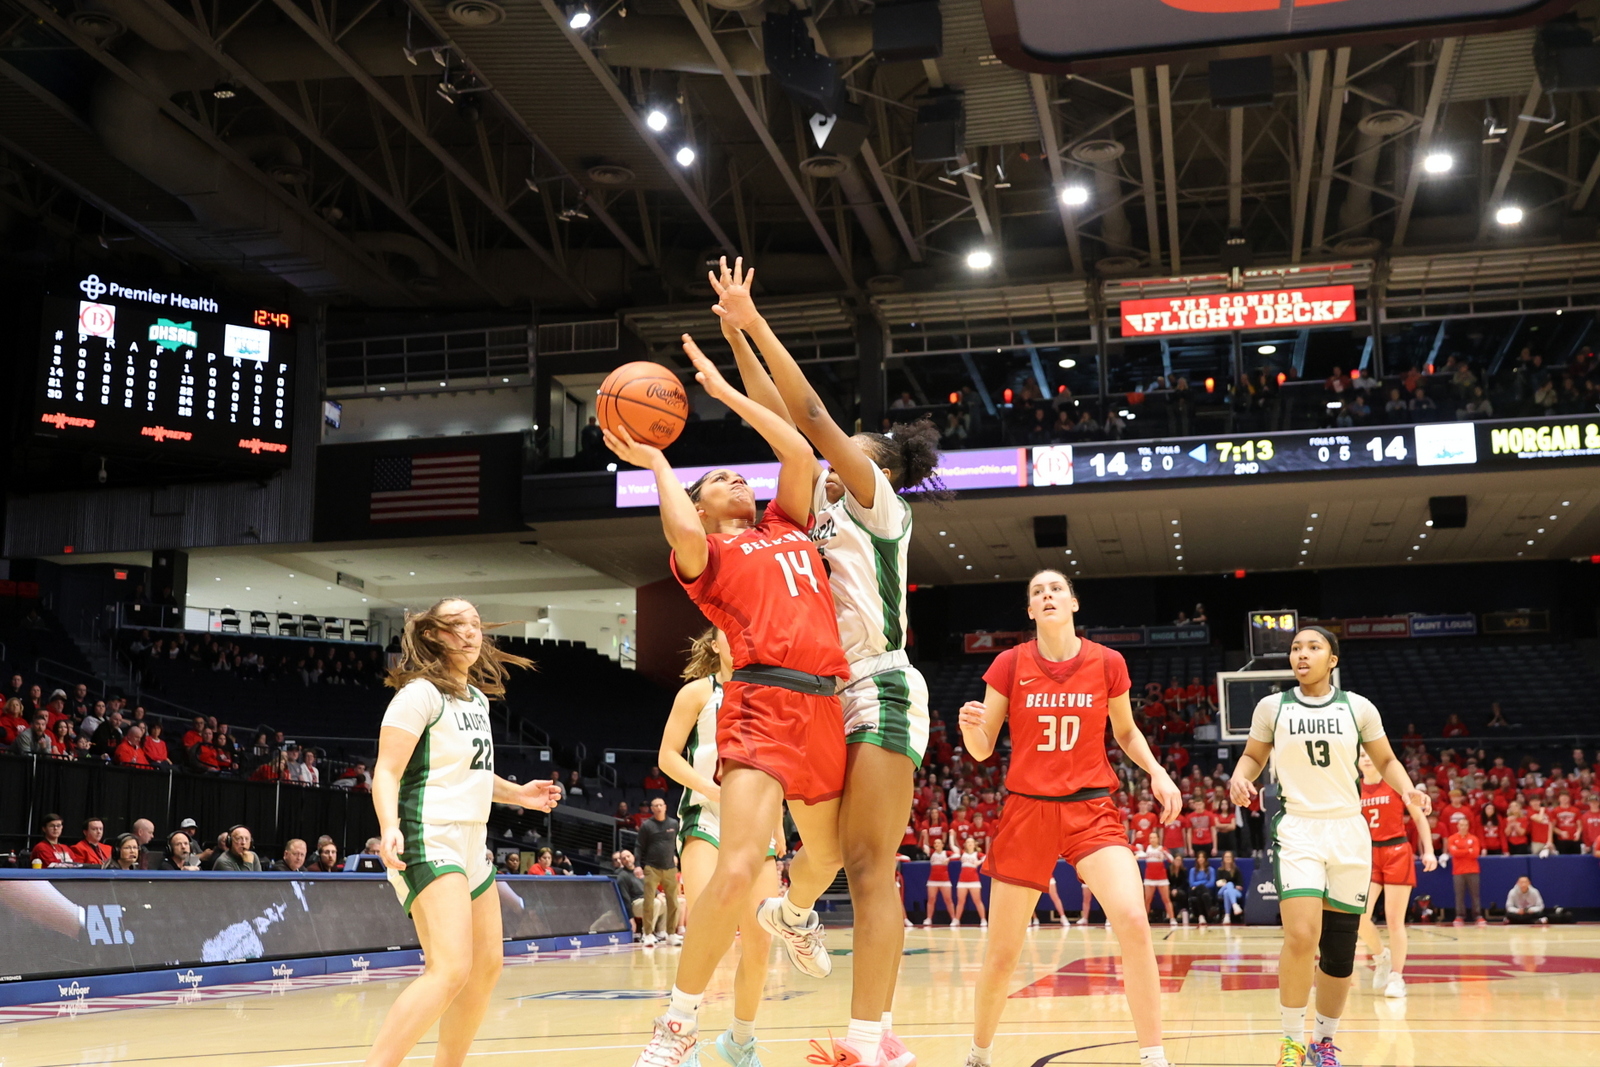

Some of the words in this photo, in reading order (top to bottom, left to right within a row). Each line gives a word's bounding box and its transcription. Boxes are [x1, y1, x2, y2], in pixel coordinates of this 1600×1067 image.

[110, 282, 167, 305] Premier
[170, 293, 219, 313] Health
[1170, 298, 1210, 311] THE
[1219, 292, 1304, 309] CONNOR
[254, 310, 289, 328] 12:49
[1142, 306, 1249, 332] FLIGHT
[1255, 301, 1334, 325] DECK
[79, 334, 88, 344] P
[106, 338, 116, 349] R
[130, 342, 138, 352] A
[156, 345, 164, 356] F
[149, 325, 198, 347] OHSAA
[78, 348, 87, 358] 0
[104, 352, 110, 361] 1
[127, 356, 133, 365] 1
[150, 359, 158, 368] 0
[208, 353, 216, 363] P
[233, 357, 241, 367] R
[255, 360, 263, 371] A
[280, 364, 287, 373] F
[50, 366, 64, 377] 14
[77, 371, 85, 380] 0
[126, 378, 134, 387] 0
[148, 381, 156, 390] 0
[78, 360, 86, 368] 0
[104, 363, 112, 372] 0
[127, 366, 134, 376] 0
[149, 370, 157, 379] 0
[184, 364, 190, 373] 1
[209, 368, 216, 377] 0
[255, 374, 262, 384] 0
[277, 378, 284, 387] 0
[102, 385, 110, 394] 0
[125, 389, 133, 398] 0
[148, 391, 155, 401] 0
[209, 378, 216, 387] 0
[232, 381, 239, 391] 0
[254, 385, 262, 394] 0
[276, 388, 284, 397] 0
[47, 389, 62, 399] 30
[147, 402, 153, 411] 1
[208, 389, 216, 399] 0
[232, 392, 239, 402] 0
[254, 396, 260, 404] 1
[276, 398, 283, 408] 0
[42, 412, 95, 429] MAXPREPS
[230, 413, 236, 423] 1
[253, 416, 260, 426] 0
[275, 419, 282, 429] 0
[276, 408, 283, 418] 0
[141, 425, 192, 442] MAXPREPS
[1309, 437, 1335, 446] FOULS
[1491, 424, 1580, 454] MORGAN
[1585, 423, 1600, 448] &
[238, 438, 287, 454] MAXPREPS
[1155, 445, 1180, 455] FOULS
[1216, 440, 1274, 462] 7:13
[1318, 447, 1330, 462] 0
[1339, 446, 1351, 461] 5
[1366, 435, 1407, 461] 14
[1090, 452, 1128, 477] 14
[1141, 457, 1152, 471] 5
[1162, 456, 1173, 470] 0
[1234, 463, 1259, 475] 2ND
[619, 485, 627, 494] Is
[628, 484, 650, 494] Your
[774, 550, 820, 597] 14
[1413, 620, 1441, 631] SAINT
[1445, 619, 1473, 630] LOUIS
[1026, 693, 1093, 708] BELLEVUE
[1037, 715, 1081, 752] 30
[1289, 718, 1343, 735] LAUREL
[469, 738, 492, 771] 22
[1305, 740, 1331, 767] 13
[1360, 795, 1390, 807] ELLEVUE
[1368, 808, 1380, 828] 2
[86, 904, 135, 945] AT.
[185, 969, 203, 987] Kroger
[68, 981, 90, 1000] Kroger
